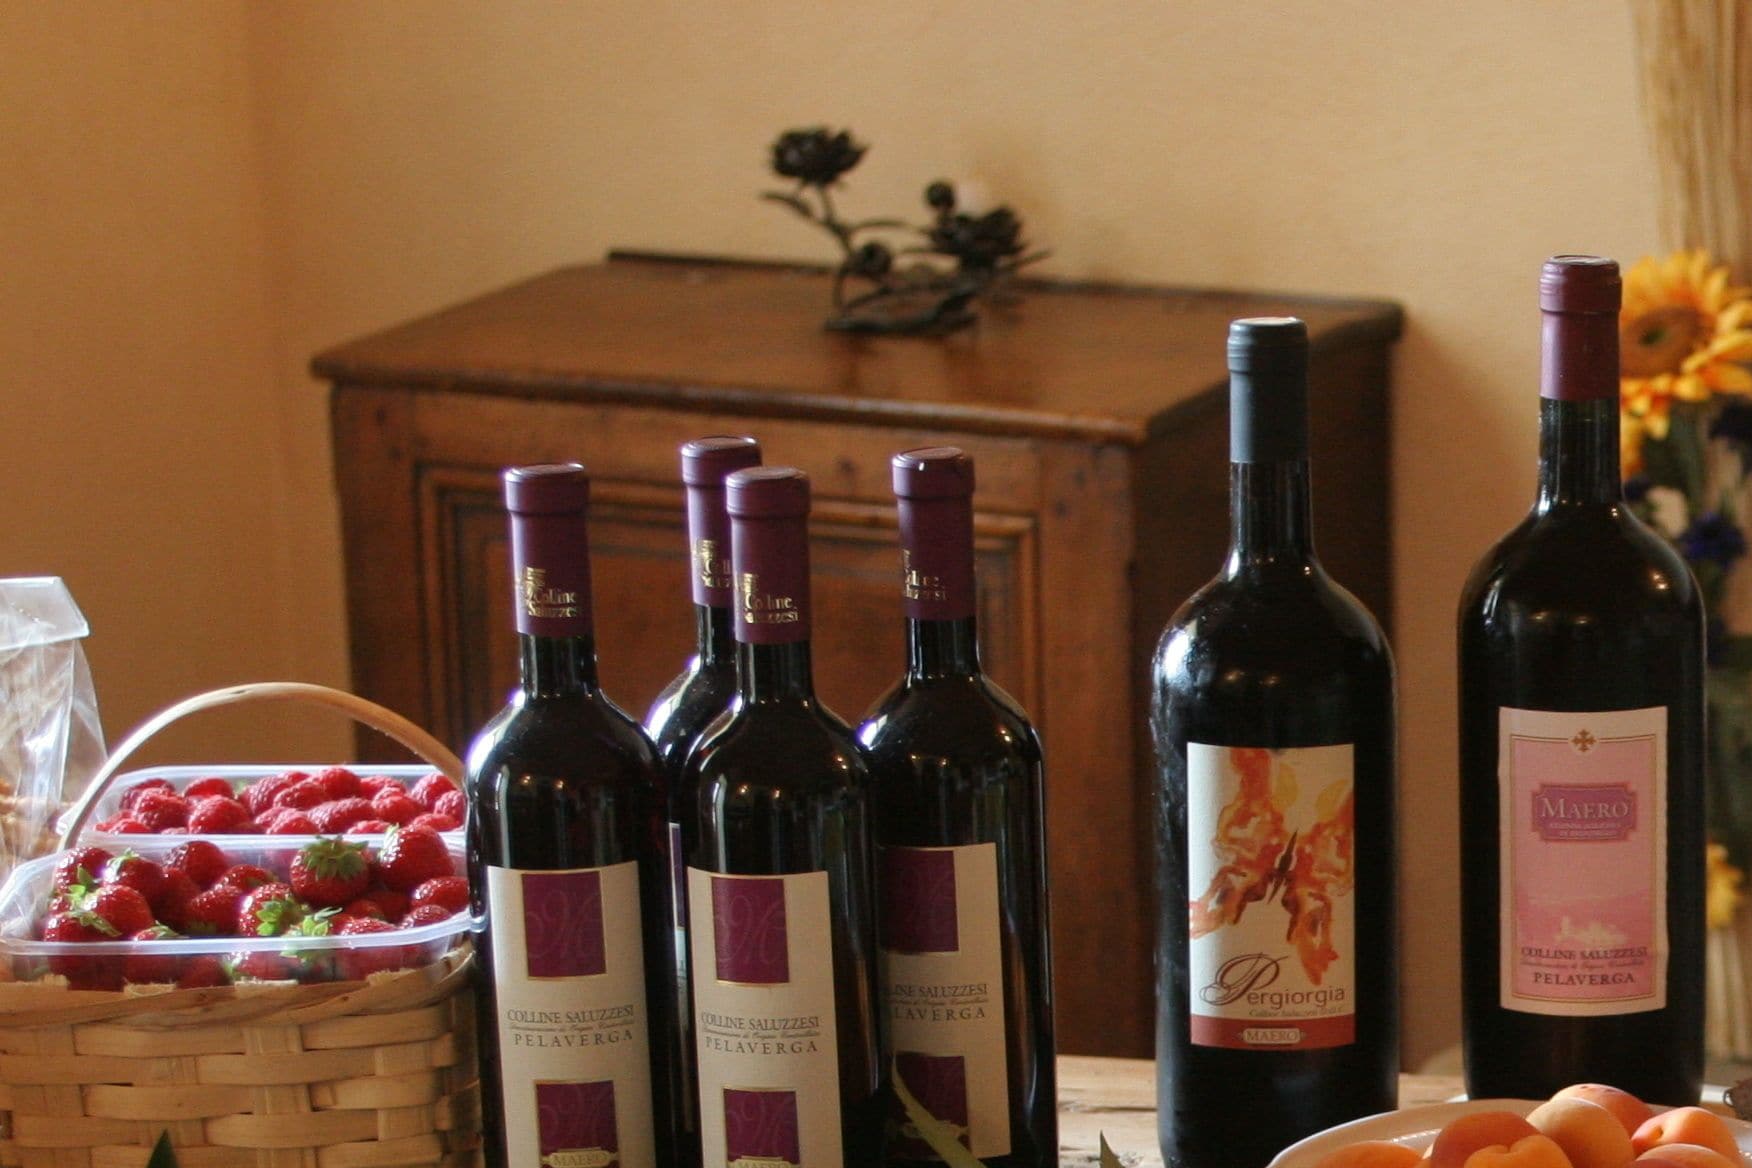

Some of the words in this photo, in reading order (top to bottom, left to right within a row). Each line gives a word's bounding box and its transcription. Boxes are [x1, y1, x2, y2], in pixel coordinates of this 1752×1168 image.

[1520, 947, 1577, 961] COLLINE
[1199, 952, 1345, 1011] Pergiorgia
[1533, 972, 1635, 986] PELAVERGA
[919, 983, 988, 998] SALUZZESI
[506, 1009, 562, 1024] COLLINE
[565, 1004, 634, 1023] SALUZZESI
[701, 1012, 745, 1030] COLLINE
[747, 1016, 820, 1031] SALUZZESI
[894, 1007, 986, 1021] LAVERGA
[513, 1029, 633, 1048] PELAVERGA
[705, 1036, 818, 1055] PELAVERGA
